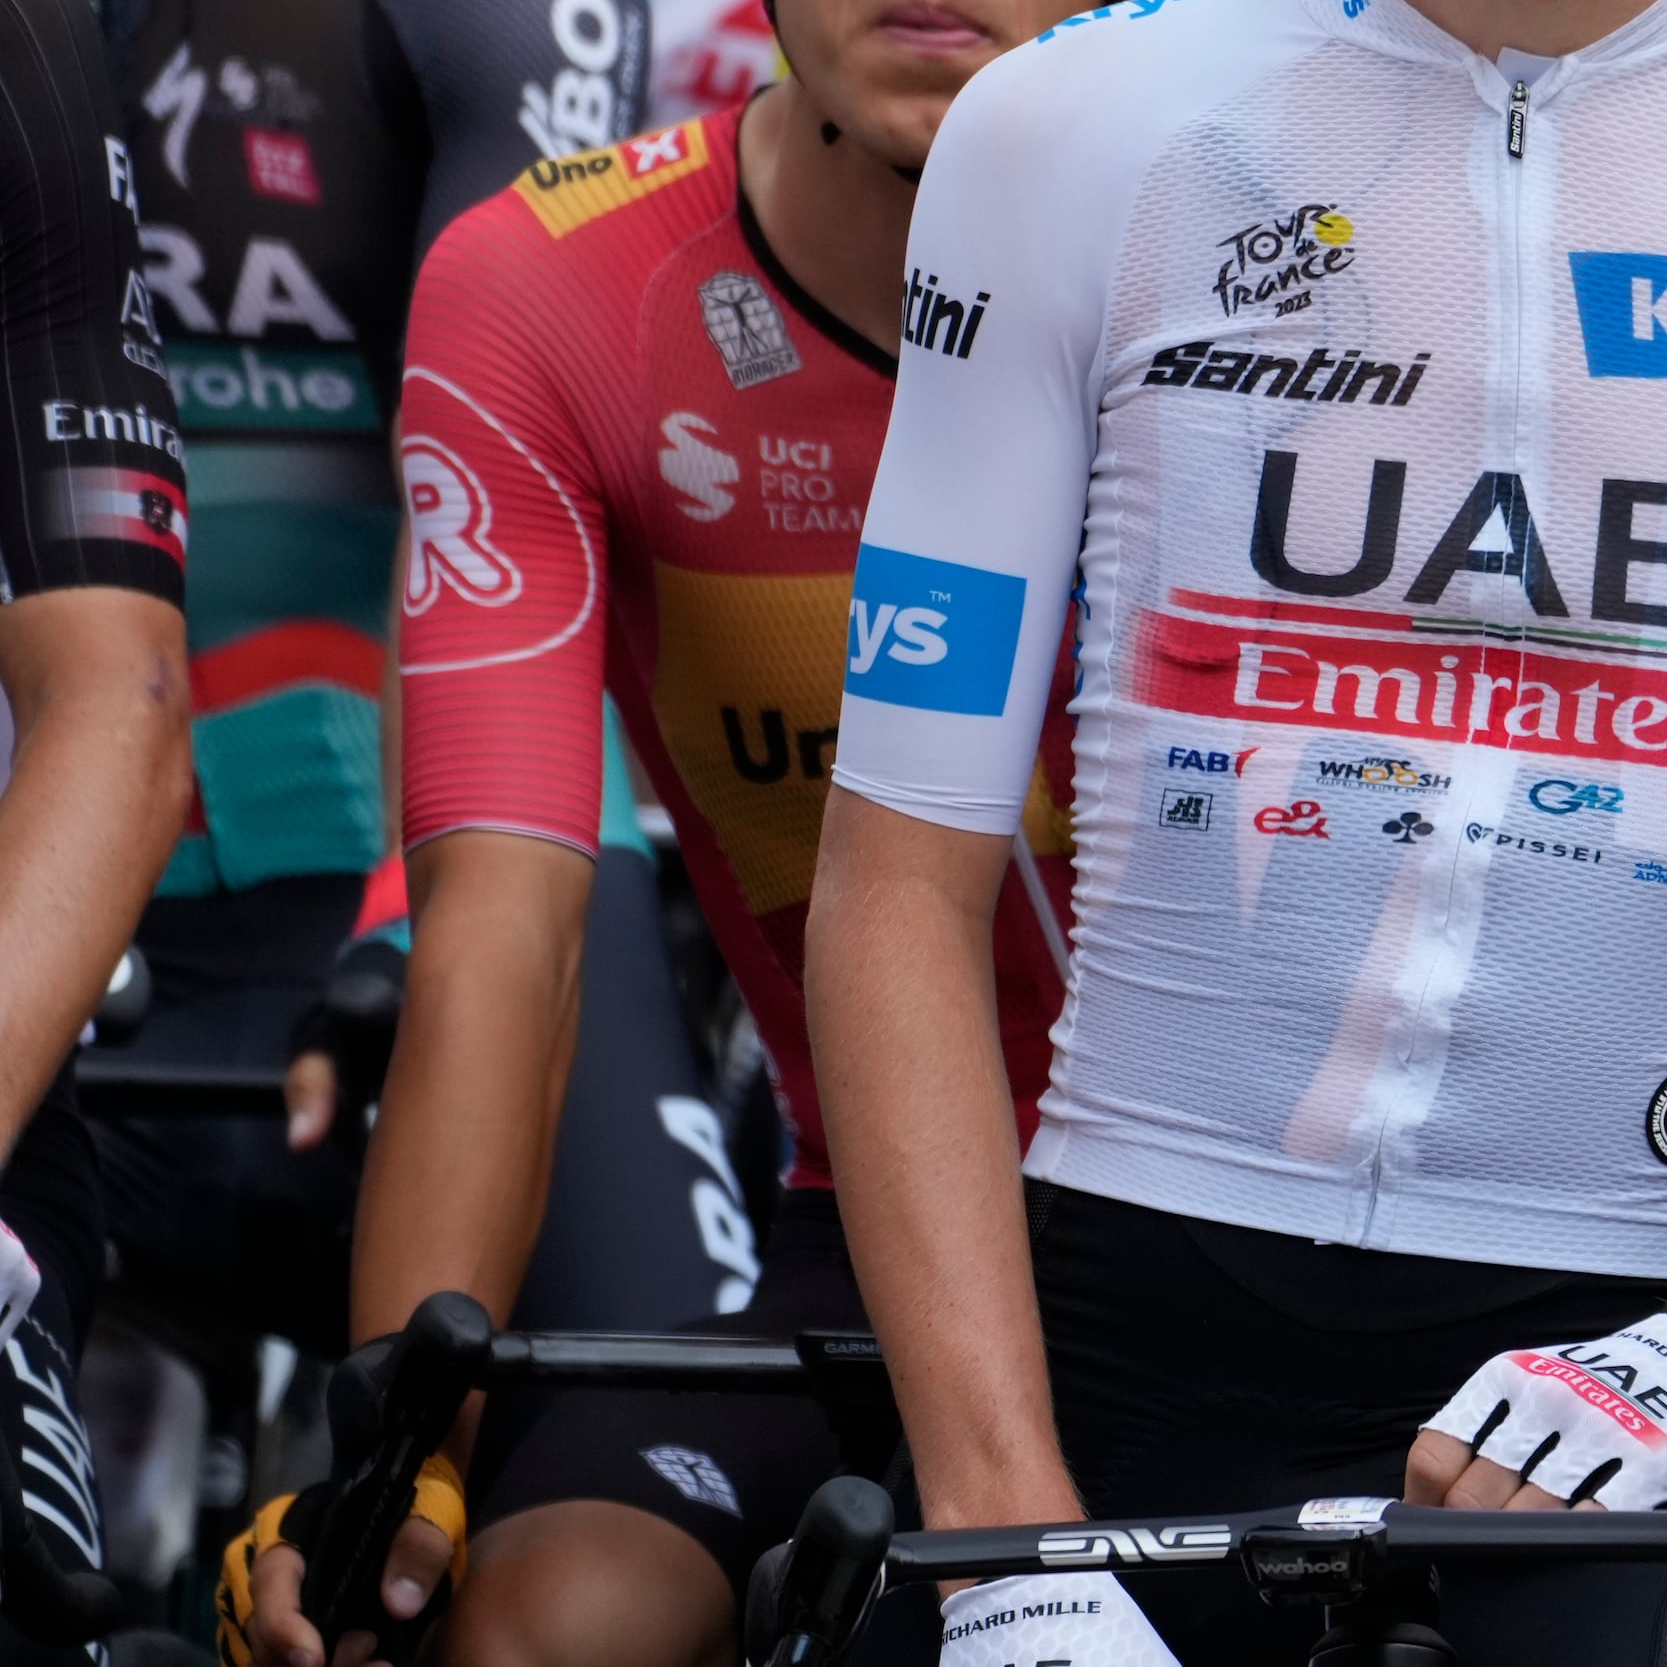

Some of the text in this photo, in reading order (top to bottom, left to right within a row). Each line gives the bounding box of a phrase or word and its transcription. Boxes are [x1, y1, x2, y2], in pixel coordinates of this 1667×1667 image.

[1509, 111, 1524, 154] Santini
[530, 155, 613, 190] Uno
[902, 267, 991, 360] tini
[1275, 289, 1313, 319] 2023
[1140, 340, 1432, 407] Santini
[42, 396, 186, 471] Emira
[759, 433, 833, 471] UCI
[760, 468, 835, 503] PRO
[762, 501, 864, 532] TEAM
[849, 596, 948, 672] ys
[721, 705, 837, 787] Un
[1167, 745, 1230, 773] FAB
[1528, 779, 1625, 815] G42
[1528, 1356, 1647, 1432] Emirates
[1037, 1523, 1232, 1567] ENVE
[1258, 1556, 1348, 1577] wahoo
[1021, 1600, 1103, 1619] MILLE
